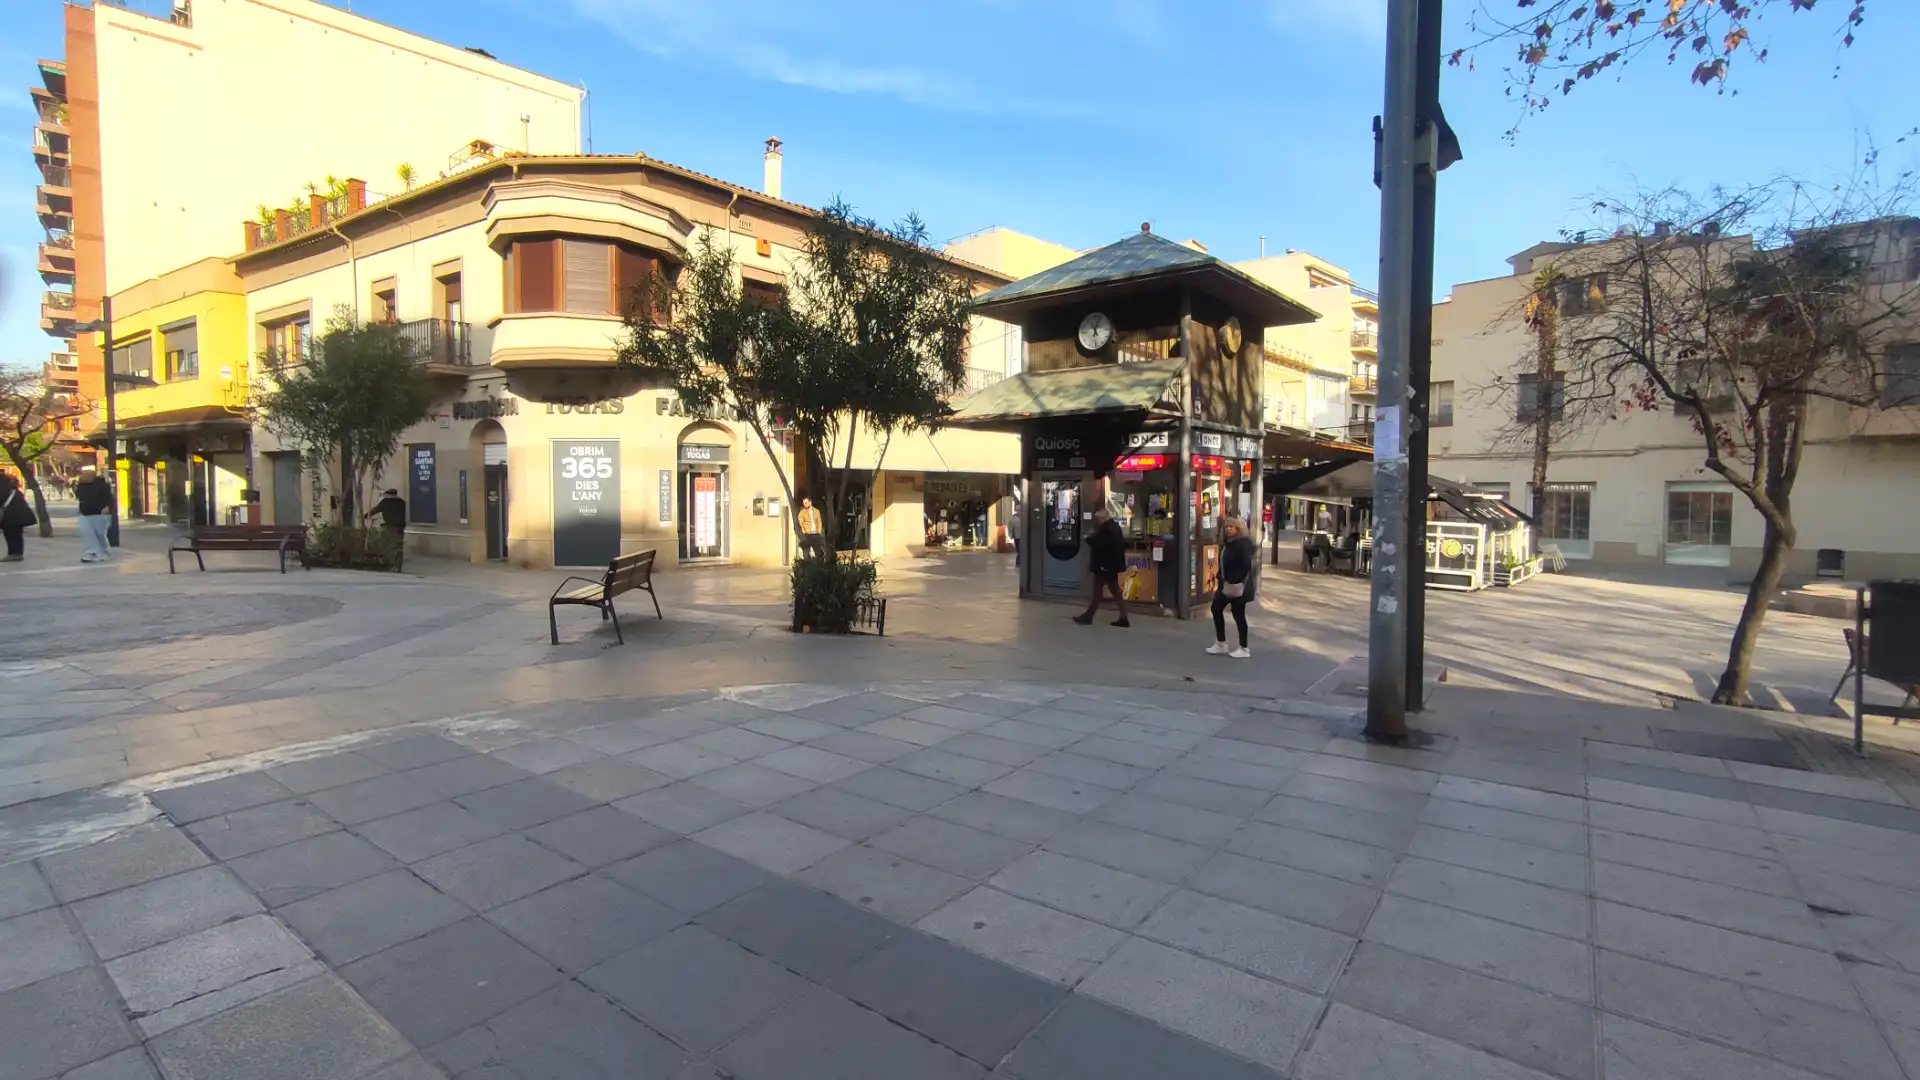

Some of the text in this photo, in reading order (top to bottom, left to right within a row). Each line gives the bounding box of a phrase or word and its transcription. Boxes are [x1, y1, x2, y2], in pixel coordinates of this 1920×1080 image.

[1035, 437, 1080, 451] Quiosc
[1132, 434, 1166, 444] ONCE
[570, 446, 604, 456] OBRIM
[687, 452, 711, 460] TUGAS
[562, 457, 612, 479] 365
[575, 481, 599, 490] DIES
[572, 491, 602, 501] L'ANY
